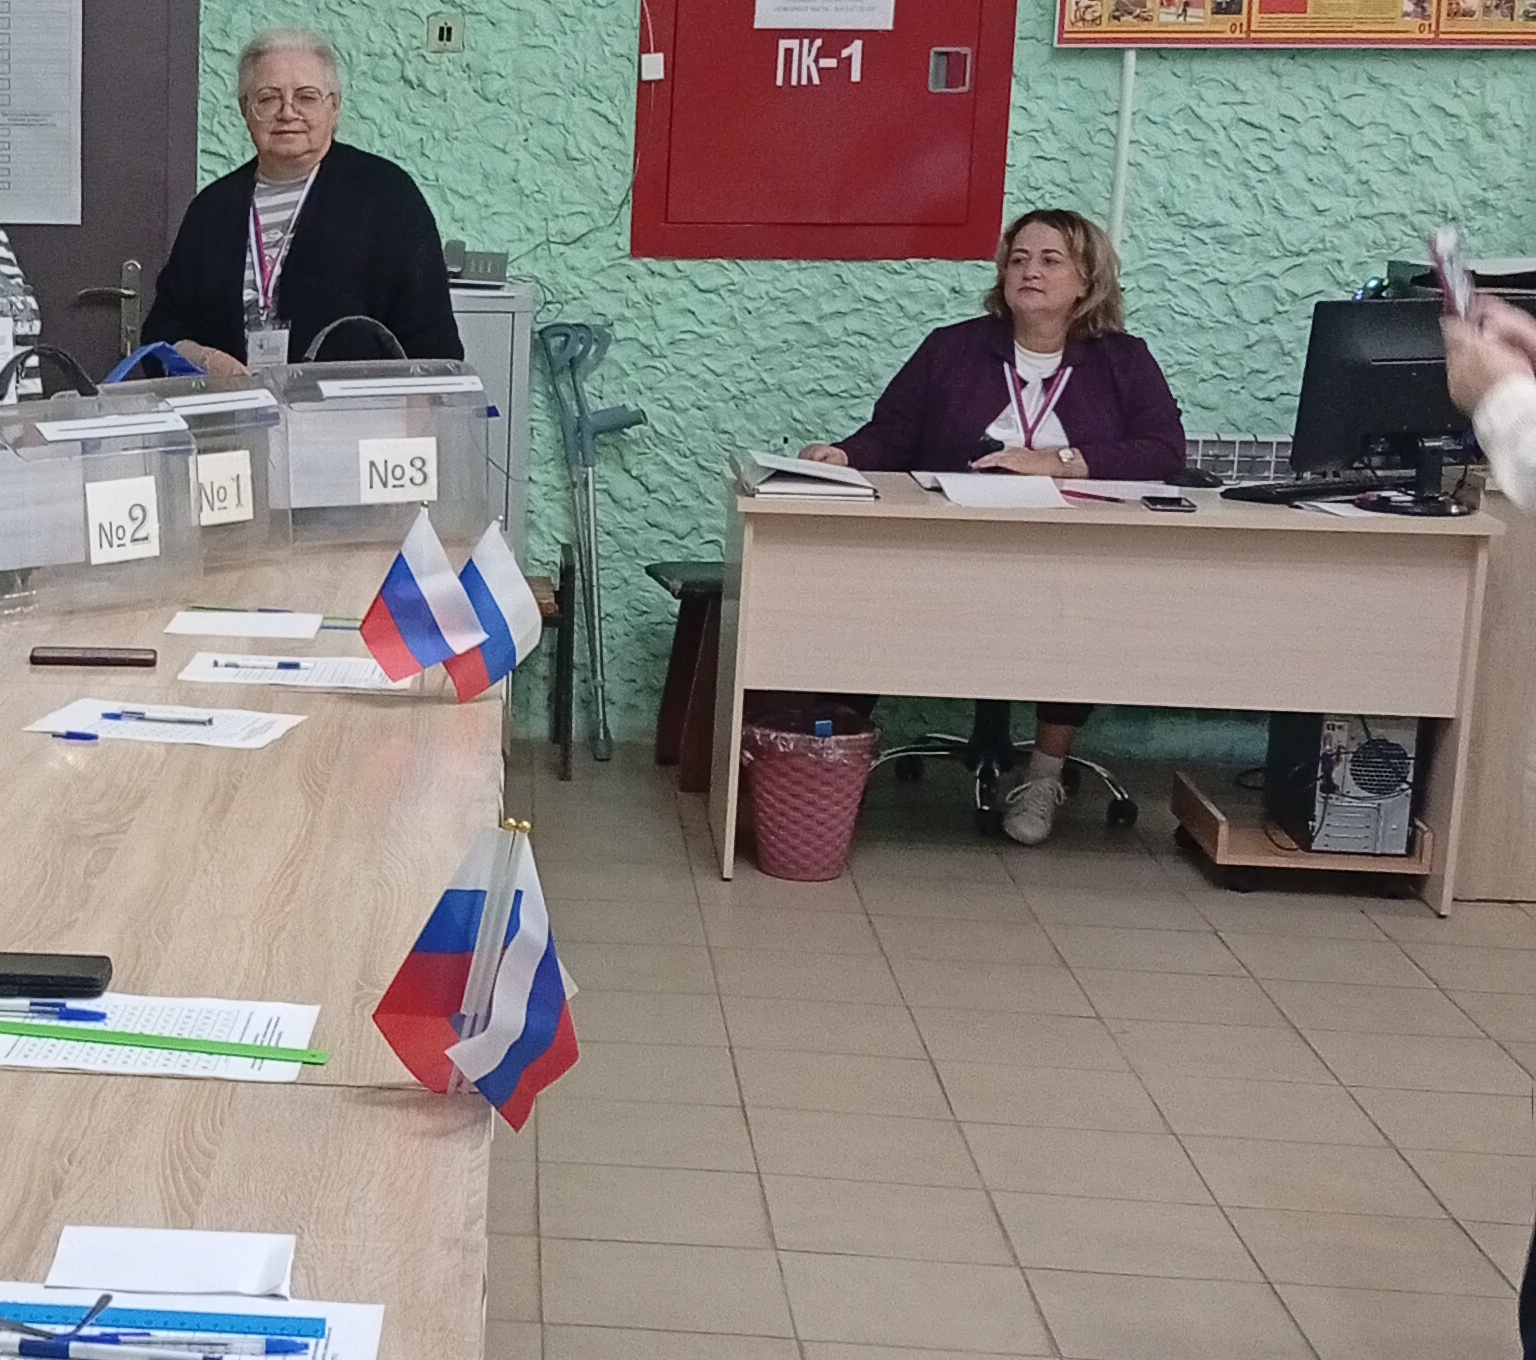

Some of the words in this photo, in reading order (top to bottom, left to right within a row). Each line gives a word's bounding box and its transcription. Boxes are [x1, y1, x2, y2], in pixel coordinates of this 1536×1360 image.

[775, 38, 863, 86] ПК-1
[199, 473, 245, 513] №1
[368, 456, 428, 489] №3
[98, 503, 149, 549] №2
